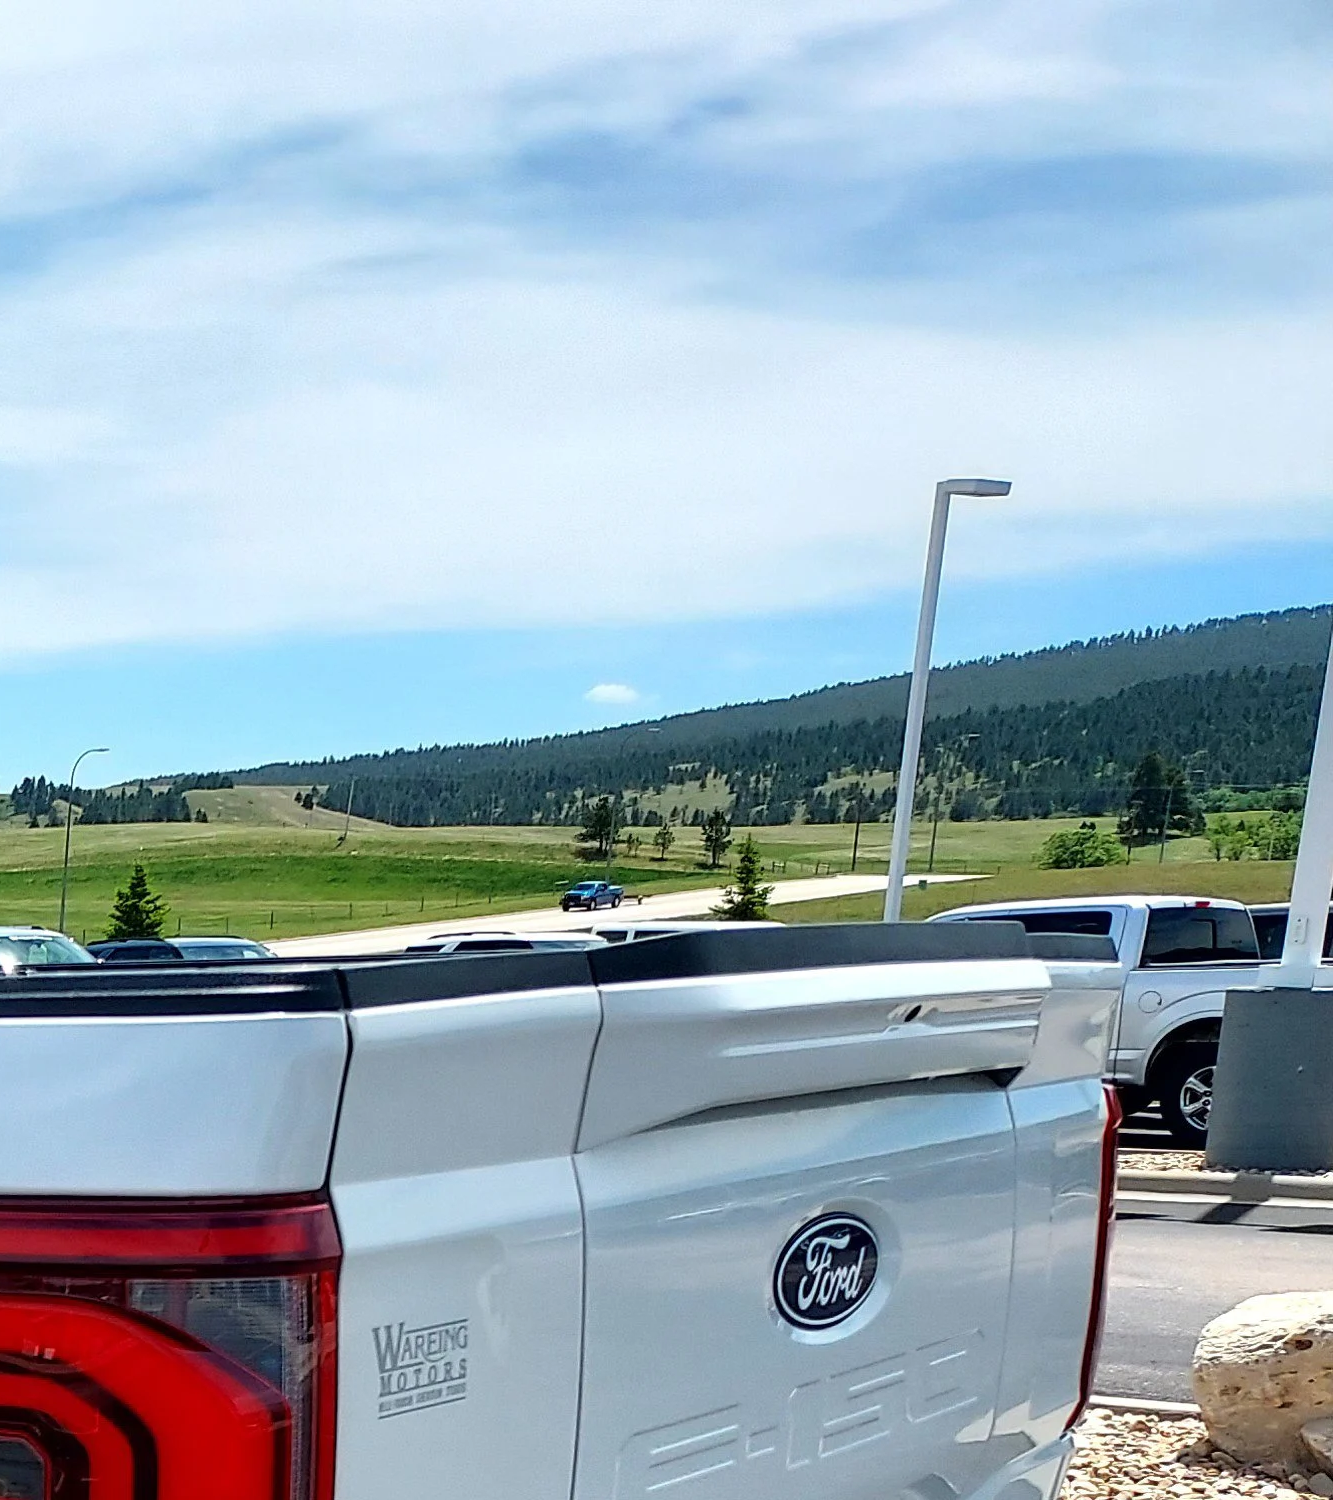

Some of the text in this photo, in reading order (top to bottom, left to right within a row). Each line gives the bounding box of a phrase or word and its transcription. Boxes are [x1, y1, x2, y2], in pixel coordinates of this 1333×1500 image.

[798, 1232, 866, 1311] Ford
[372, 1321, 469, 1374] WAREING
[379, 1358, 467, 1396] MOTORS
